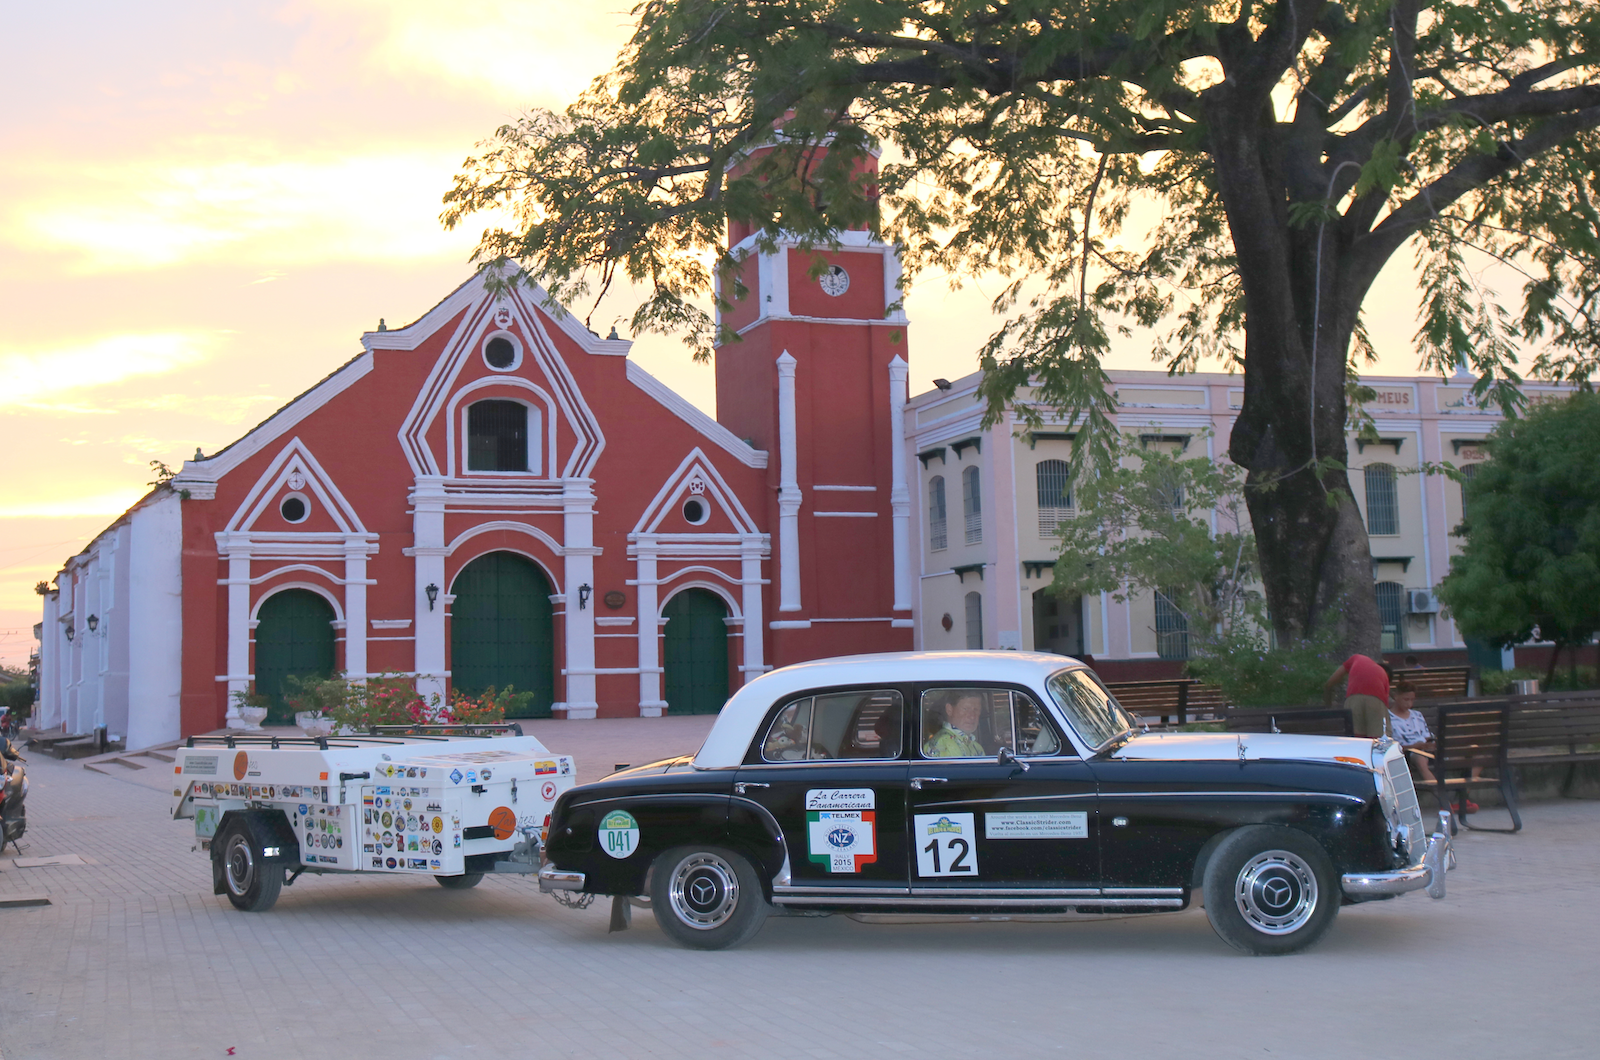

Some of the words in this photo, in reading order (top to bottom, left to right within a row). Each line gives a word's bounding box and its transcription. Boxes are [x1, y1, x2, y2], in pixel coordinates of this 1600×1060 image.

[1377, 391, 1409, 404] MEUS
[813, 790, 827, 800] La
[830, 790, 866, 801] Carrera
[809, 799, 872, 809] Panamericana
[607, 830, 630, 852] 041
[833, 832, 849, 844] NZ
[924, 838, 971, 873] 12
[833, 858, 852, 866] 2015
